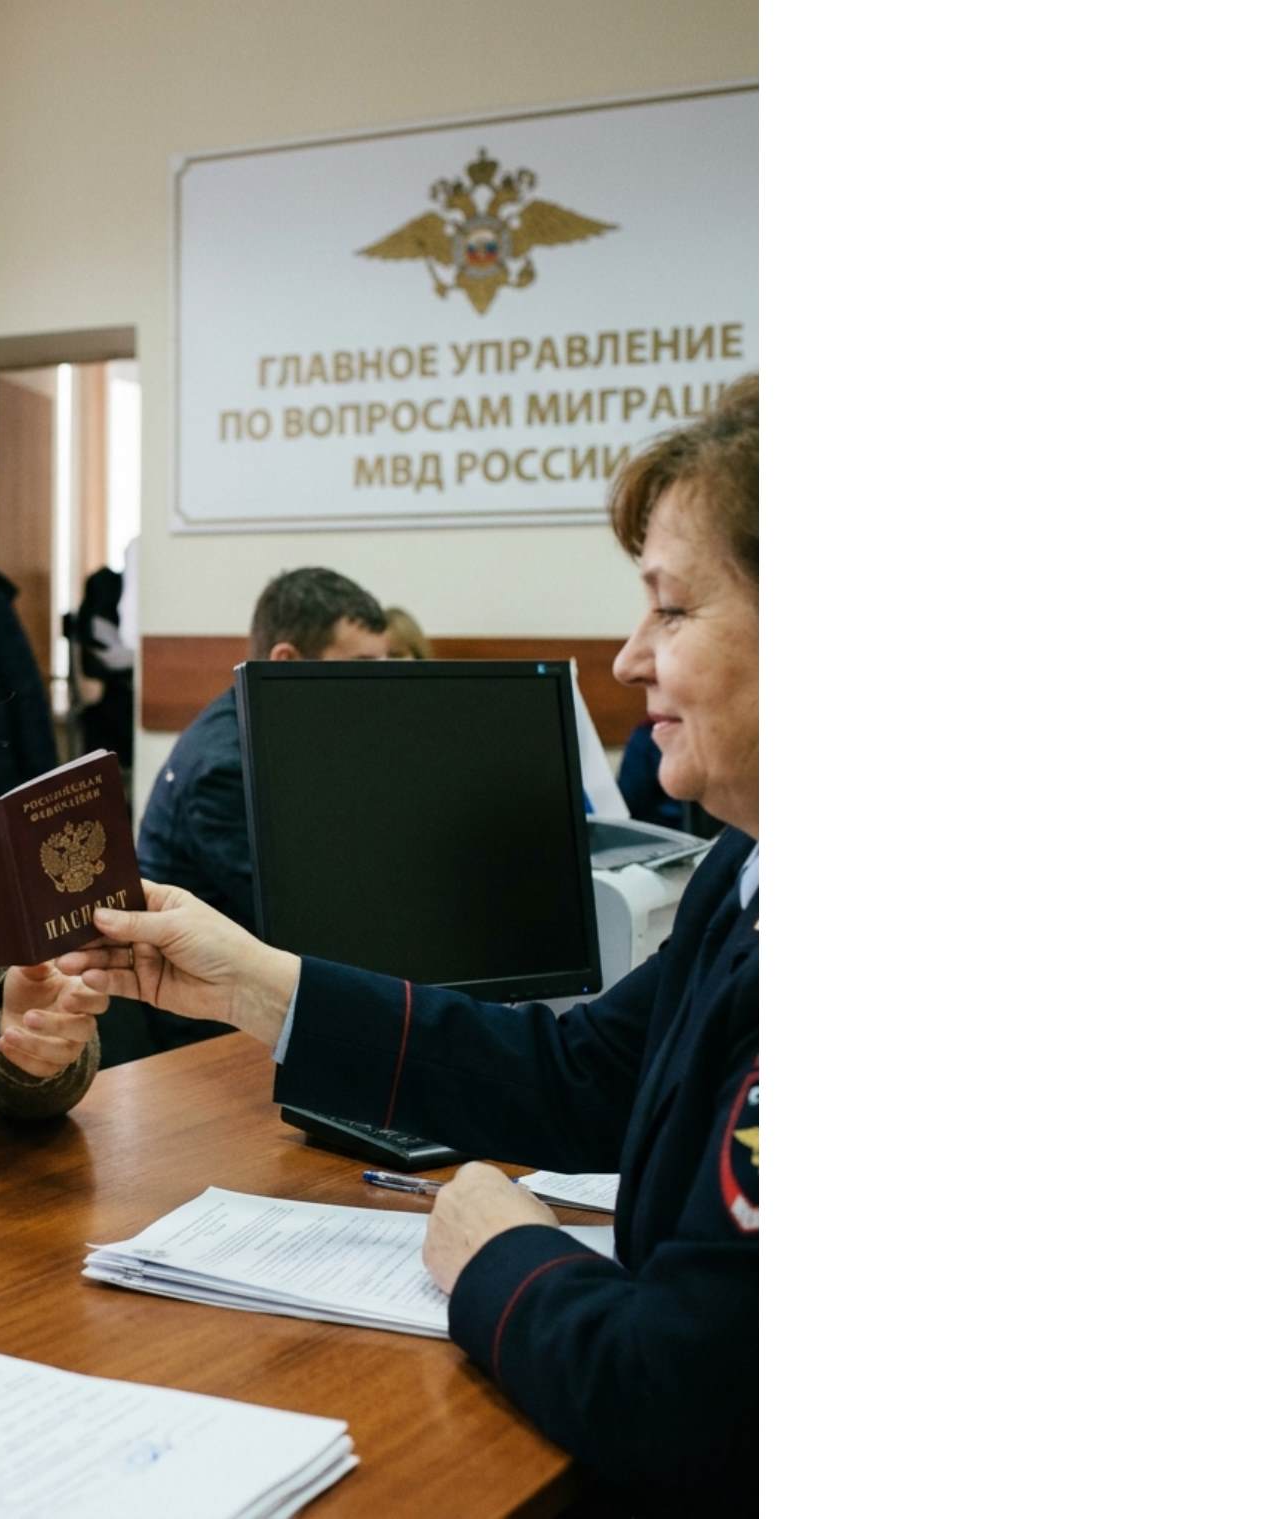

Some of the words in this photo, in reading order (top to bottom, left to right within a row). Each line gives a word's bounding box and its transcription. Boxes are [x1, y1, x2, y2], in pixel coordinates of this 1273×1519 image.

[258, 343, 438, 388] ГЛАВНОЕ
[451, 322, 743, 376] УПРАВЛЕНИЕ
[219, 408, 272, 442] ПО
[284, 395, 512, 440] ВОПРОСАМ
[525, 382, 728, 428] МИГРАЦ
[354, 452, 444, 491] МВД
